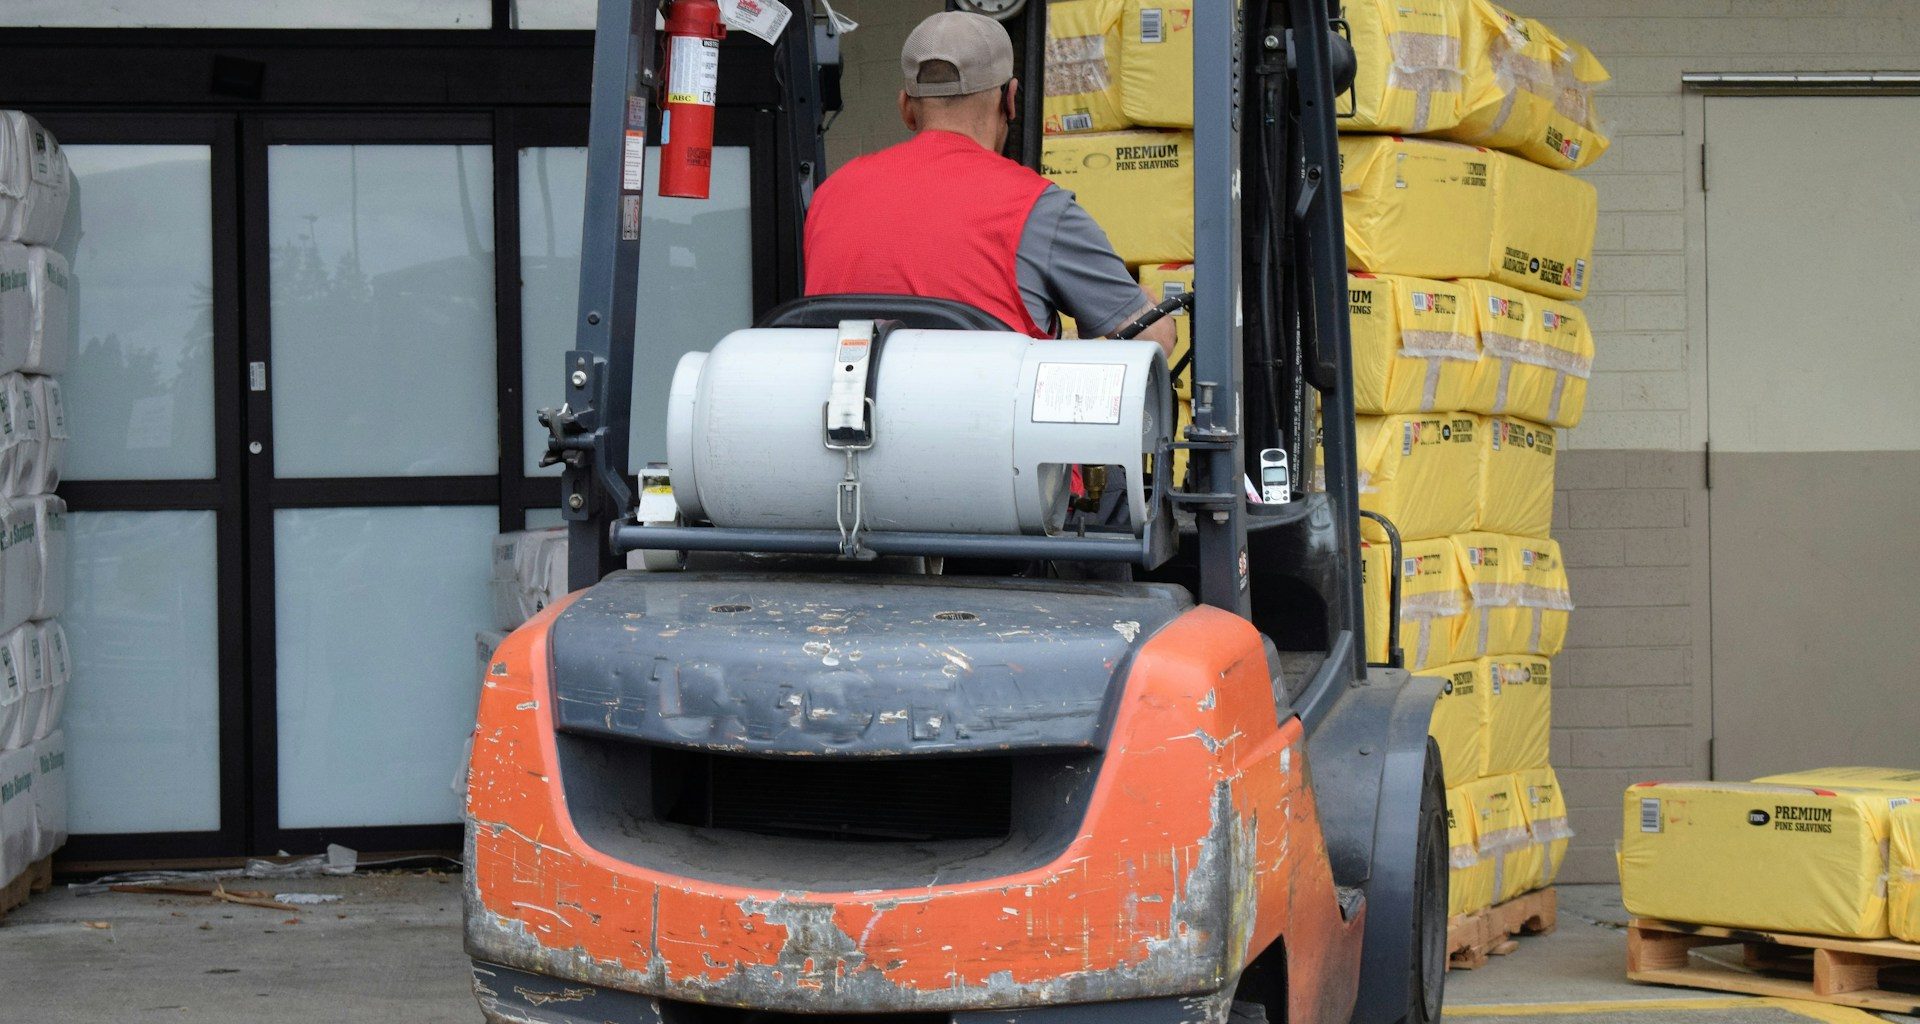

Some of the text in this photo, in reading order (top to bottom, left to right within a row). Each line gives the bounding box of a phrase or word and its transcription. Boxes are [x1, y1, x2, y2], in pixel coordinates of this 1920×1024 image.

[1116, 144, 1179, 160] PREMIUM
[1116, 159, 1179, 171] PINE SHAVINGS
[1775, 806, 1832, 822] PREMIUM
[1775, 821, 1832, 834] PINE SHAVINGS
